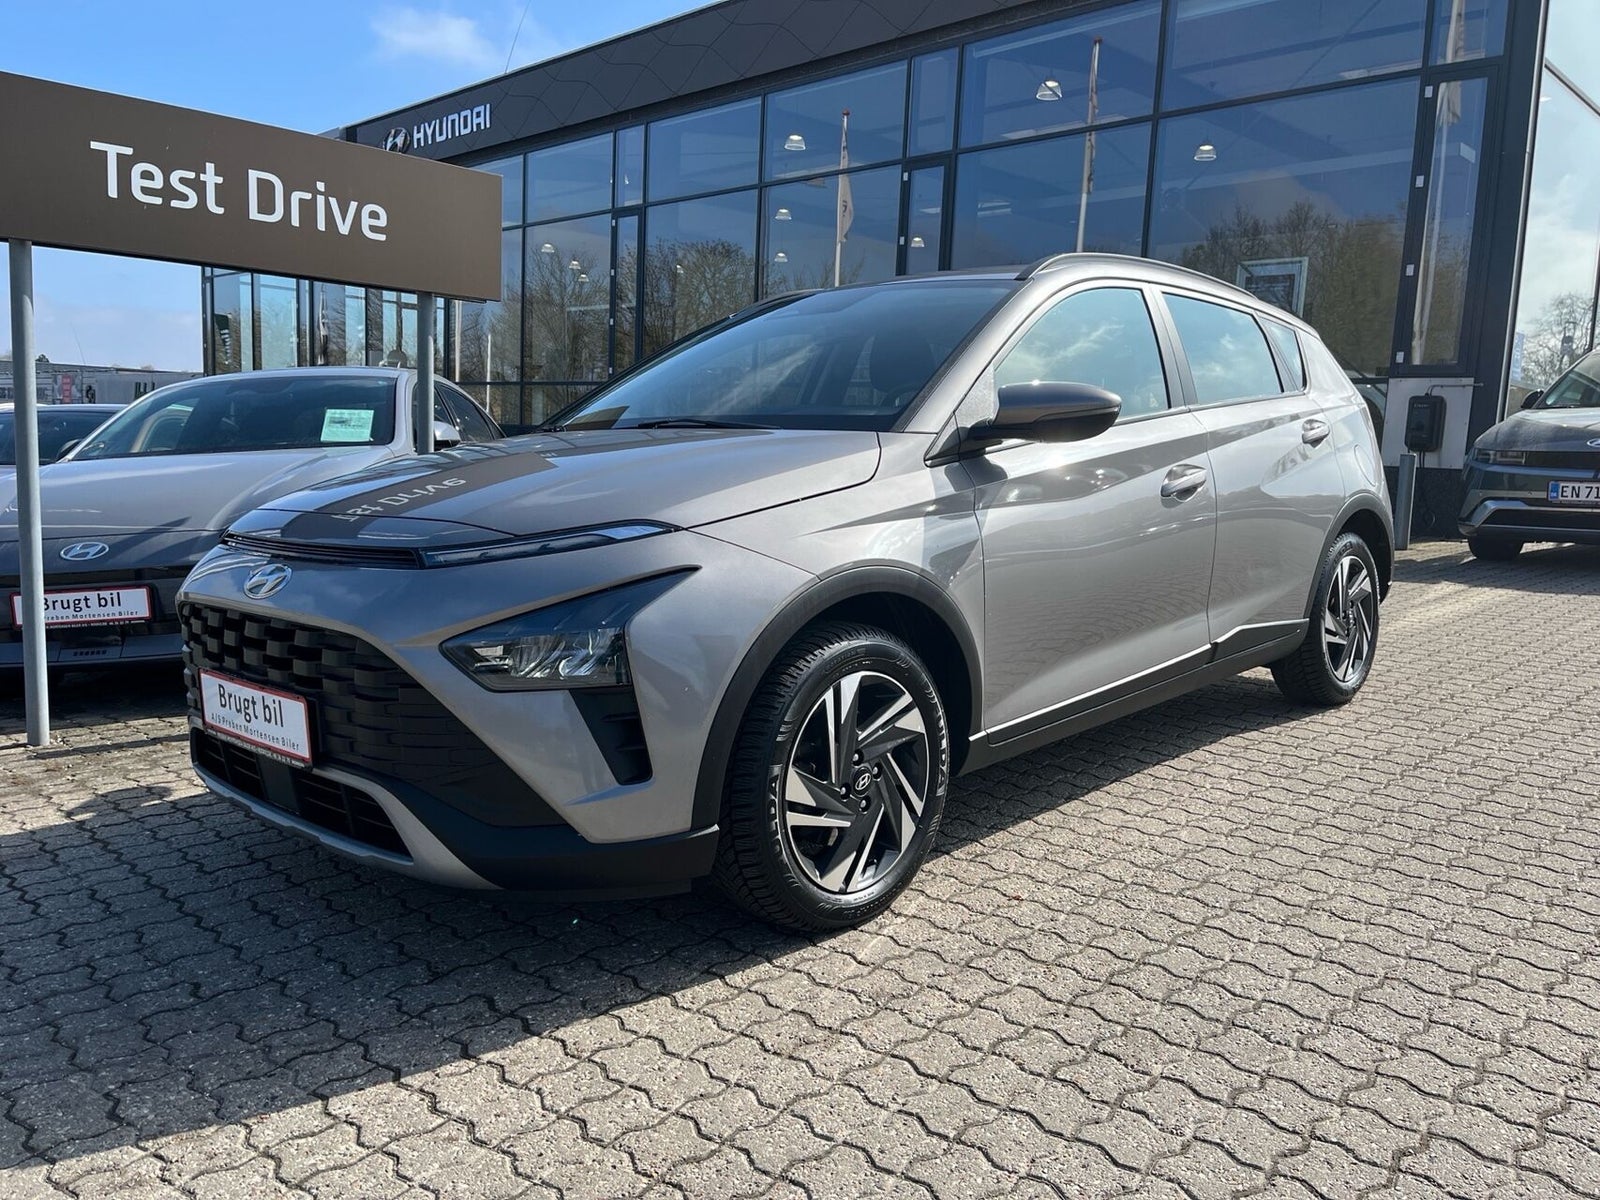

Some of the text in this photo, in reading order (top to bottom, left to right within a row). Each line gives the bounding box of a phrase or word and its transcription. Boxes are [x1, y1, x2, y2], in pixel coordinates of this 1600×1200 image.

[413, 103, 491, 149] HYUNDAI
[89, 140, 388, 242] Test Drive
[1561, 485, 1580, 498] EN
[97, 592, 121, 608] bil
[72, 612, 116, 620] Mortensen
[218, 683, 284, 727] Brugt bil
[244, 724, 279, 745] Mortensen
[281, 736, 299, 751] Biler
